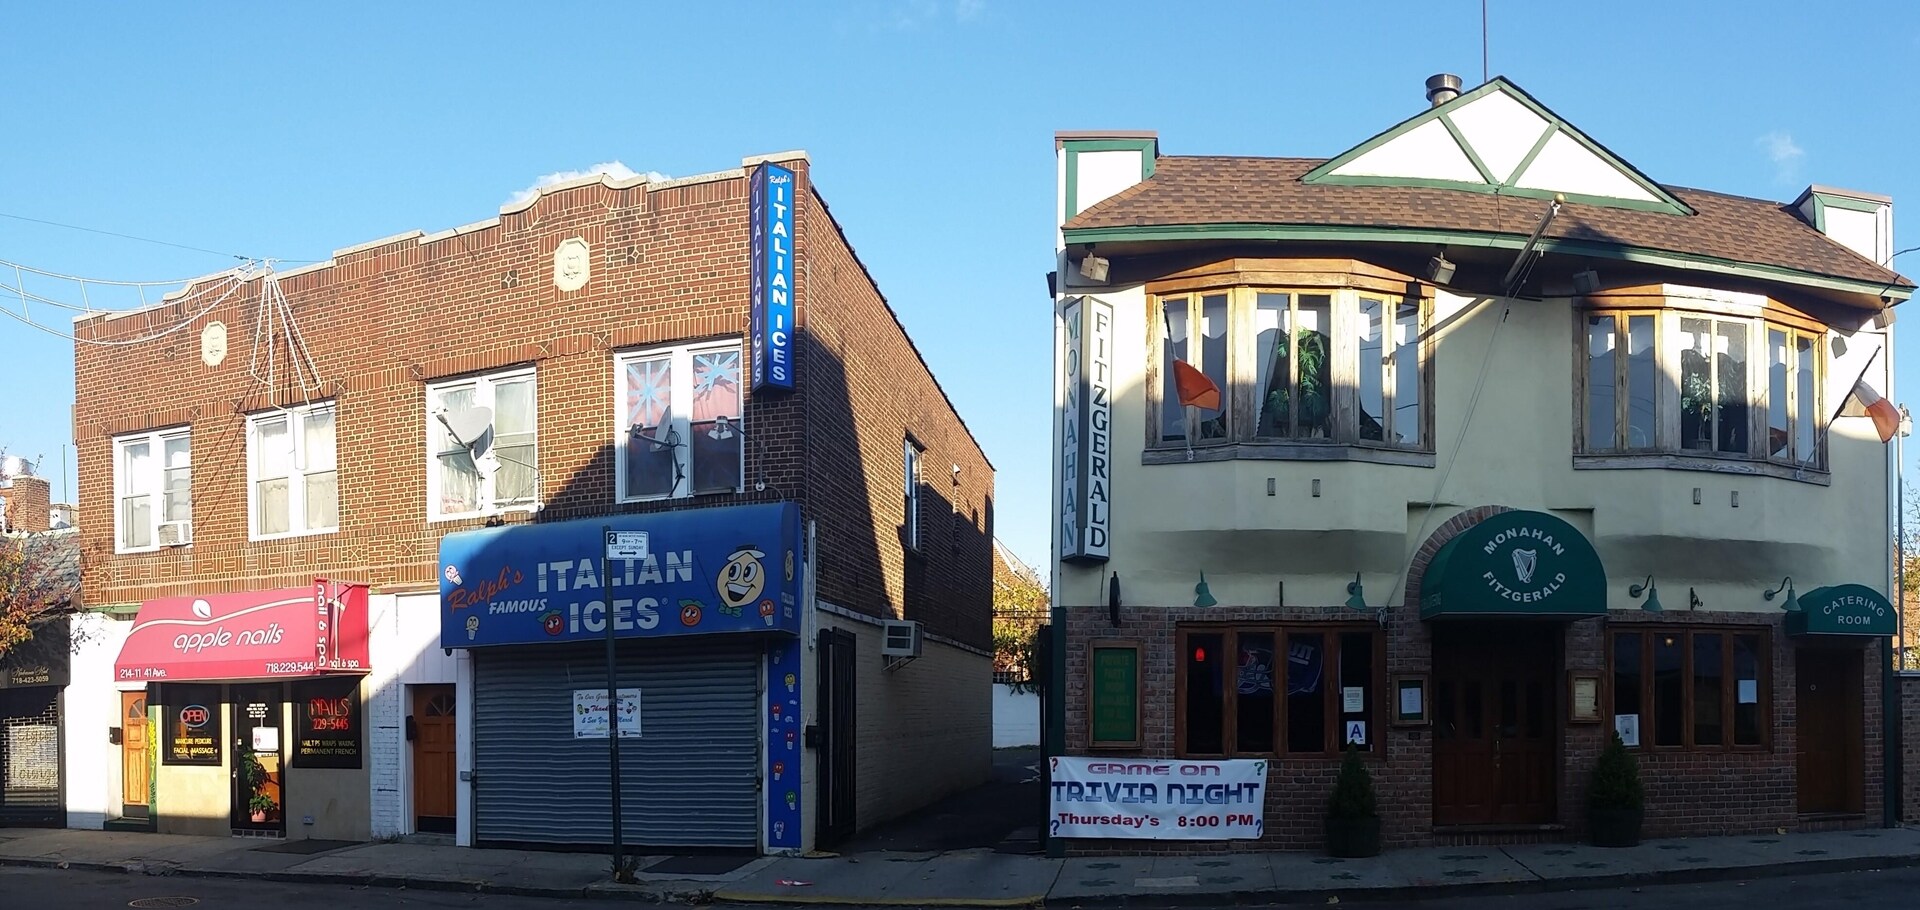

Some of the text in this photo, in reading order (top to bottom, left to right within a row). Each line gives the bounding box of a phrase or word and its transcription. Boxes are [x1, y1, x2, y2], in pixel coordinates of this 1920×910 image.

[754, 190, 762, 309] ITALIAN
[771, 186, 788, 381] ITALIAN ICES
[754, 316, 762, 383] ICES
[1063, 312, 1080, 549] MONAHAN
[1089, 312, 1108, 548] FITZGERALD
[609, 533, 616, 544] 2
[1483, 527, 1564, 556] MONAHAN
[448, 565, 523, 614] Ralph's
[1482, 570, 1567, 602] FITZGERALD
[317, 584, 328, 615] nail
[489, 599, 547, 614] FAMOUS
[1823, 595, 1885, 617] CATERING
[569, 597, 660, 633] ICES
[1837, 615, 1871, 625] ROOM
[173, 623, 284, 654] apple nails
[316, 636, 326, 667] spa
[120, 668, 141, 678] 214-11
[143, 668, 152, 677] 41
[182, 709, 207, 722] OPEN
[309, 698, 349, 717] NAILS
[313, 718, 349, 730] 229-5445
[1349, 723, 1363, 738] A
[1087, 763, 1220, 776] GAME ON
[1051, 781, 1260, 805] TRIVIA NIGHT
[1058, 813, 1254, 829] Thursday's 8:00 PM
